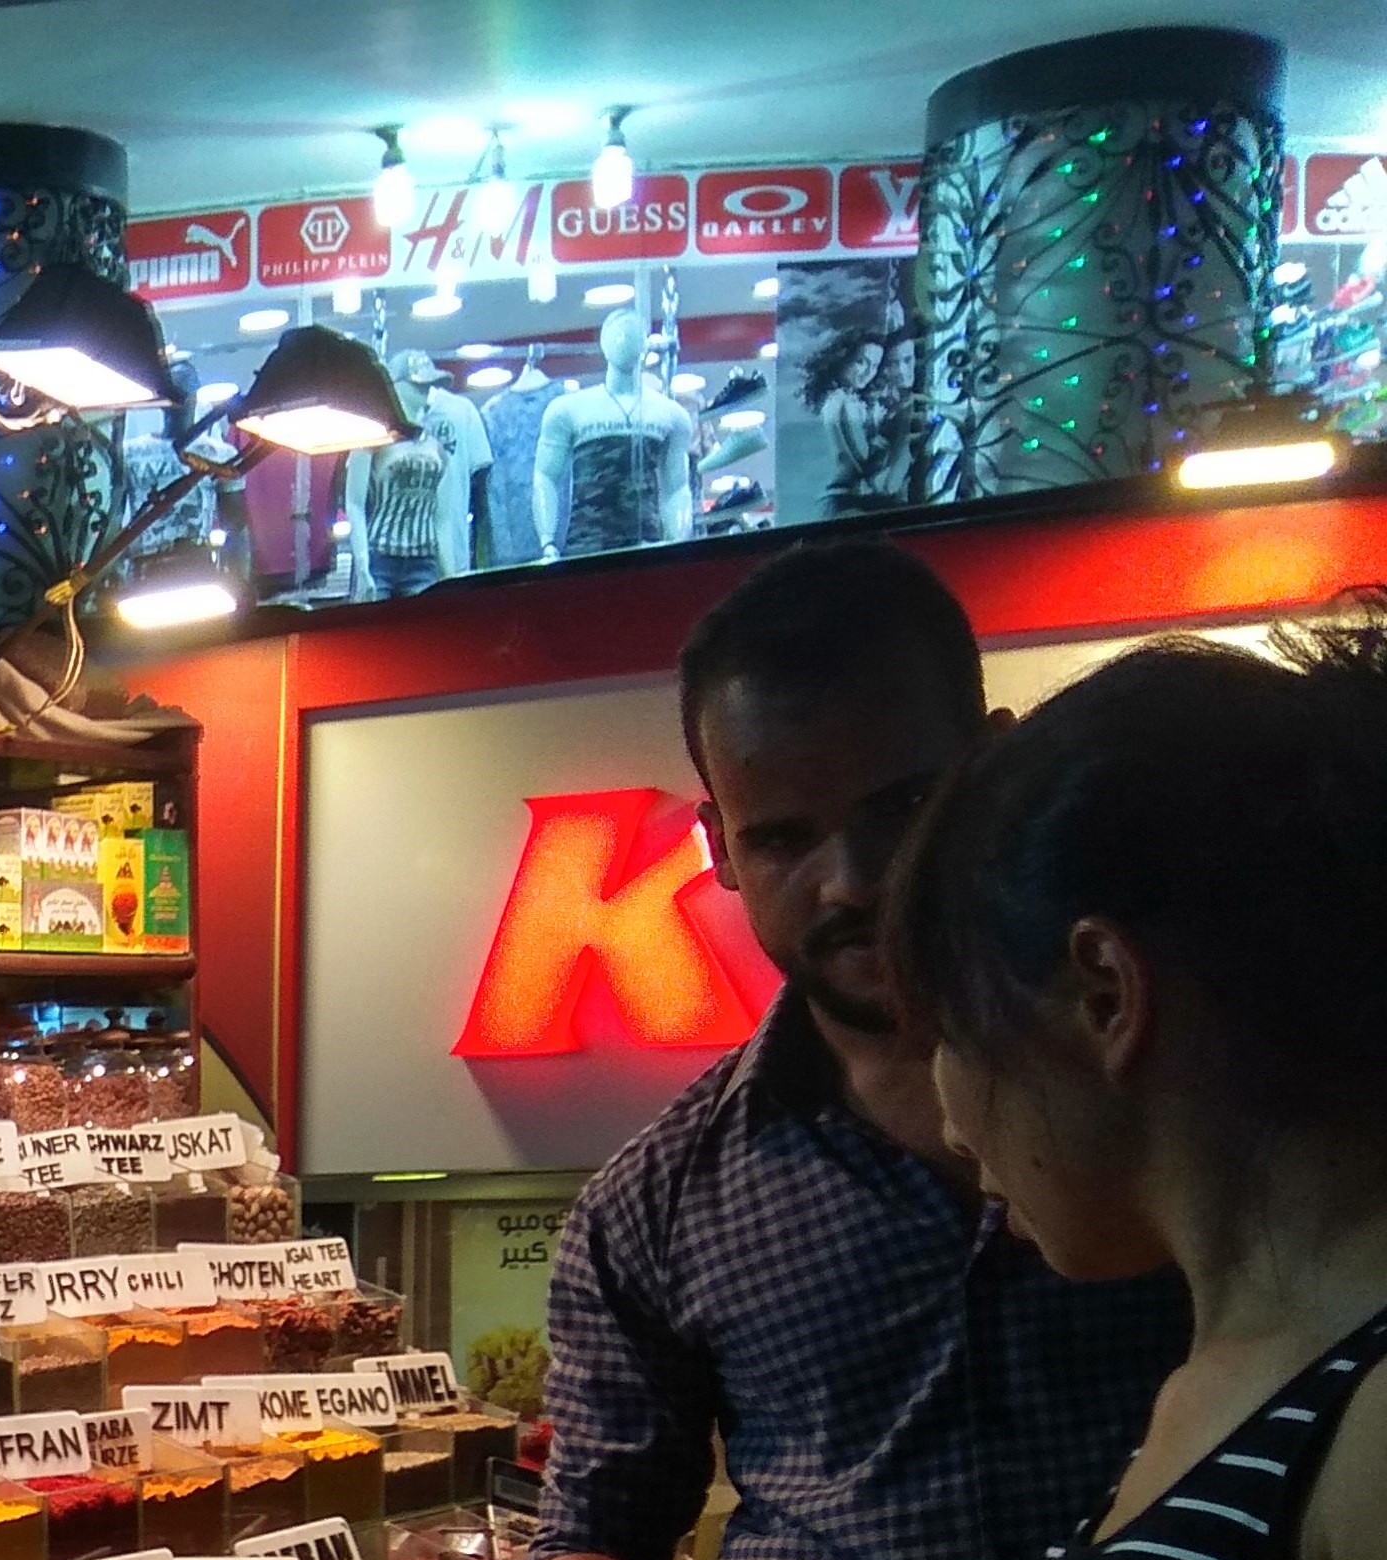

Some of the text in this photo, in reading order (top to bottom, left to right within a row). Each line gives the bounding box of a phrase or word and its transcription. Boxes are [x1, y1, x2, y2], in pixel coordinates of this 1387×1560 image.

[557, 202, 687, 238] GUESS
[702, 216, 827, 238] OAKLEY
[129, 250, 220, 291] PUMA
[262, 252, 388, 279] PHILIPP PLEIN
[22, 1163, 64, 1187] TEE
[101, 1157, 143, 1175] TEE
[316, 1243, 348, 1261] TEE
[499, 1241, 549, 1270] كبير
[127, 1270, 184, 1292] CHILI
[316, 1386, 390, 1416] EGANO
[151, 1401, 230, 1431] ZIMT
[86, 1418, 134, 1441] BABA
